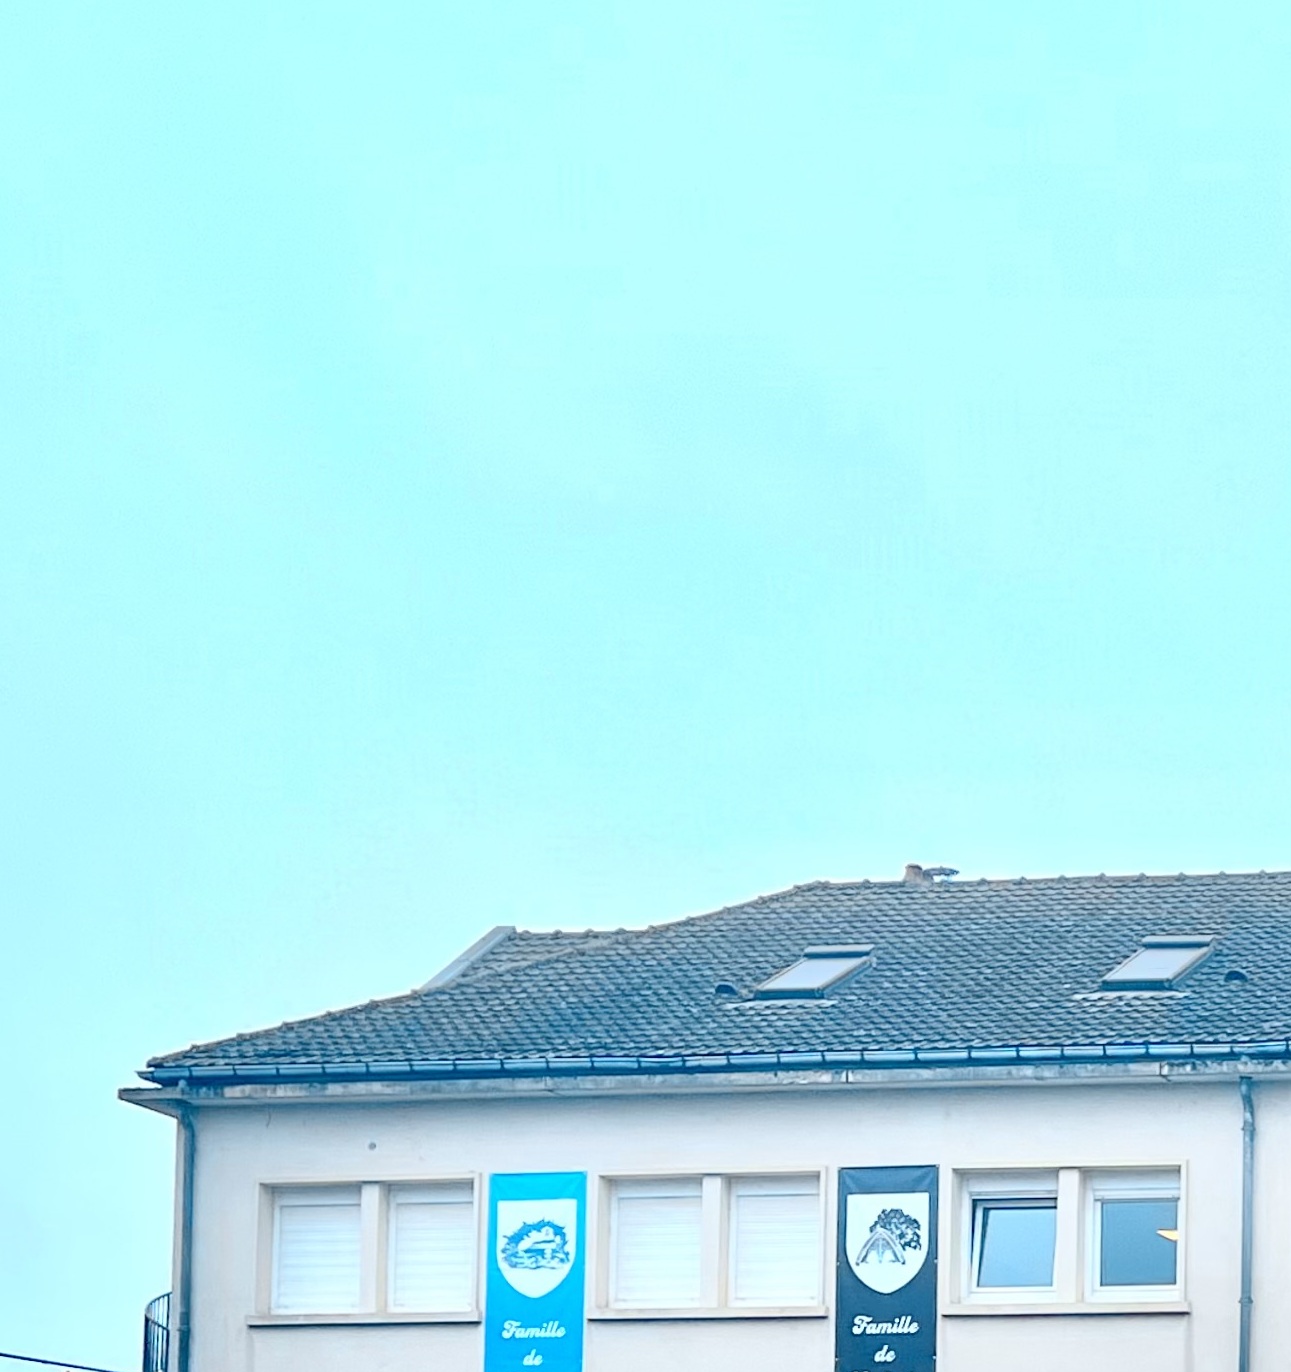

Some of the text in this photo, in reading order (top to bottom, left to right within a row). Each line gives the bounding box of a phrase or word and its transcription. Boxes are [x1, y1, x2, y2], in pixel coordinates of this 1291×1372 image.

[501, 1319, 567, 1339] Famille
[851, 1315, 919, 1335] Famille
[522, 1348, 544, 1367] de
[874, 1344, 896, 1363] de
